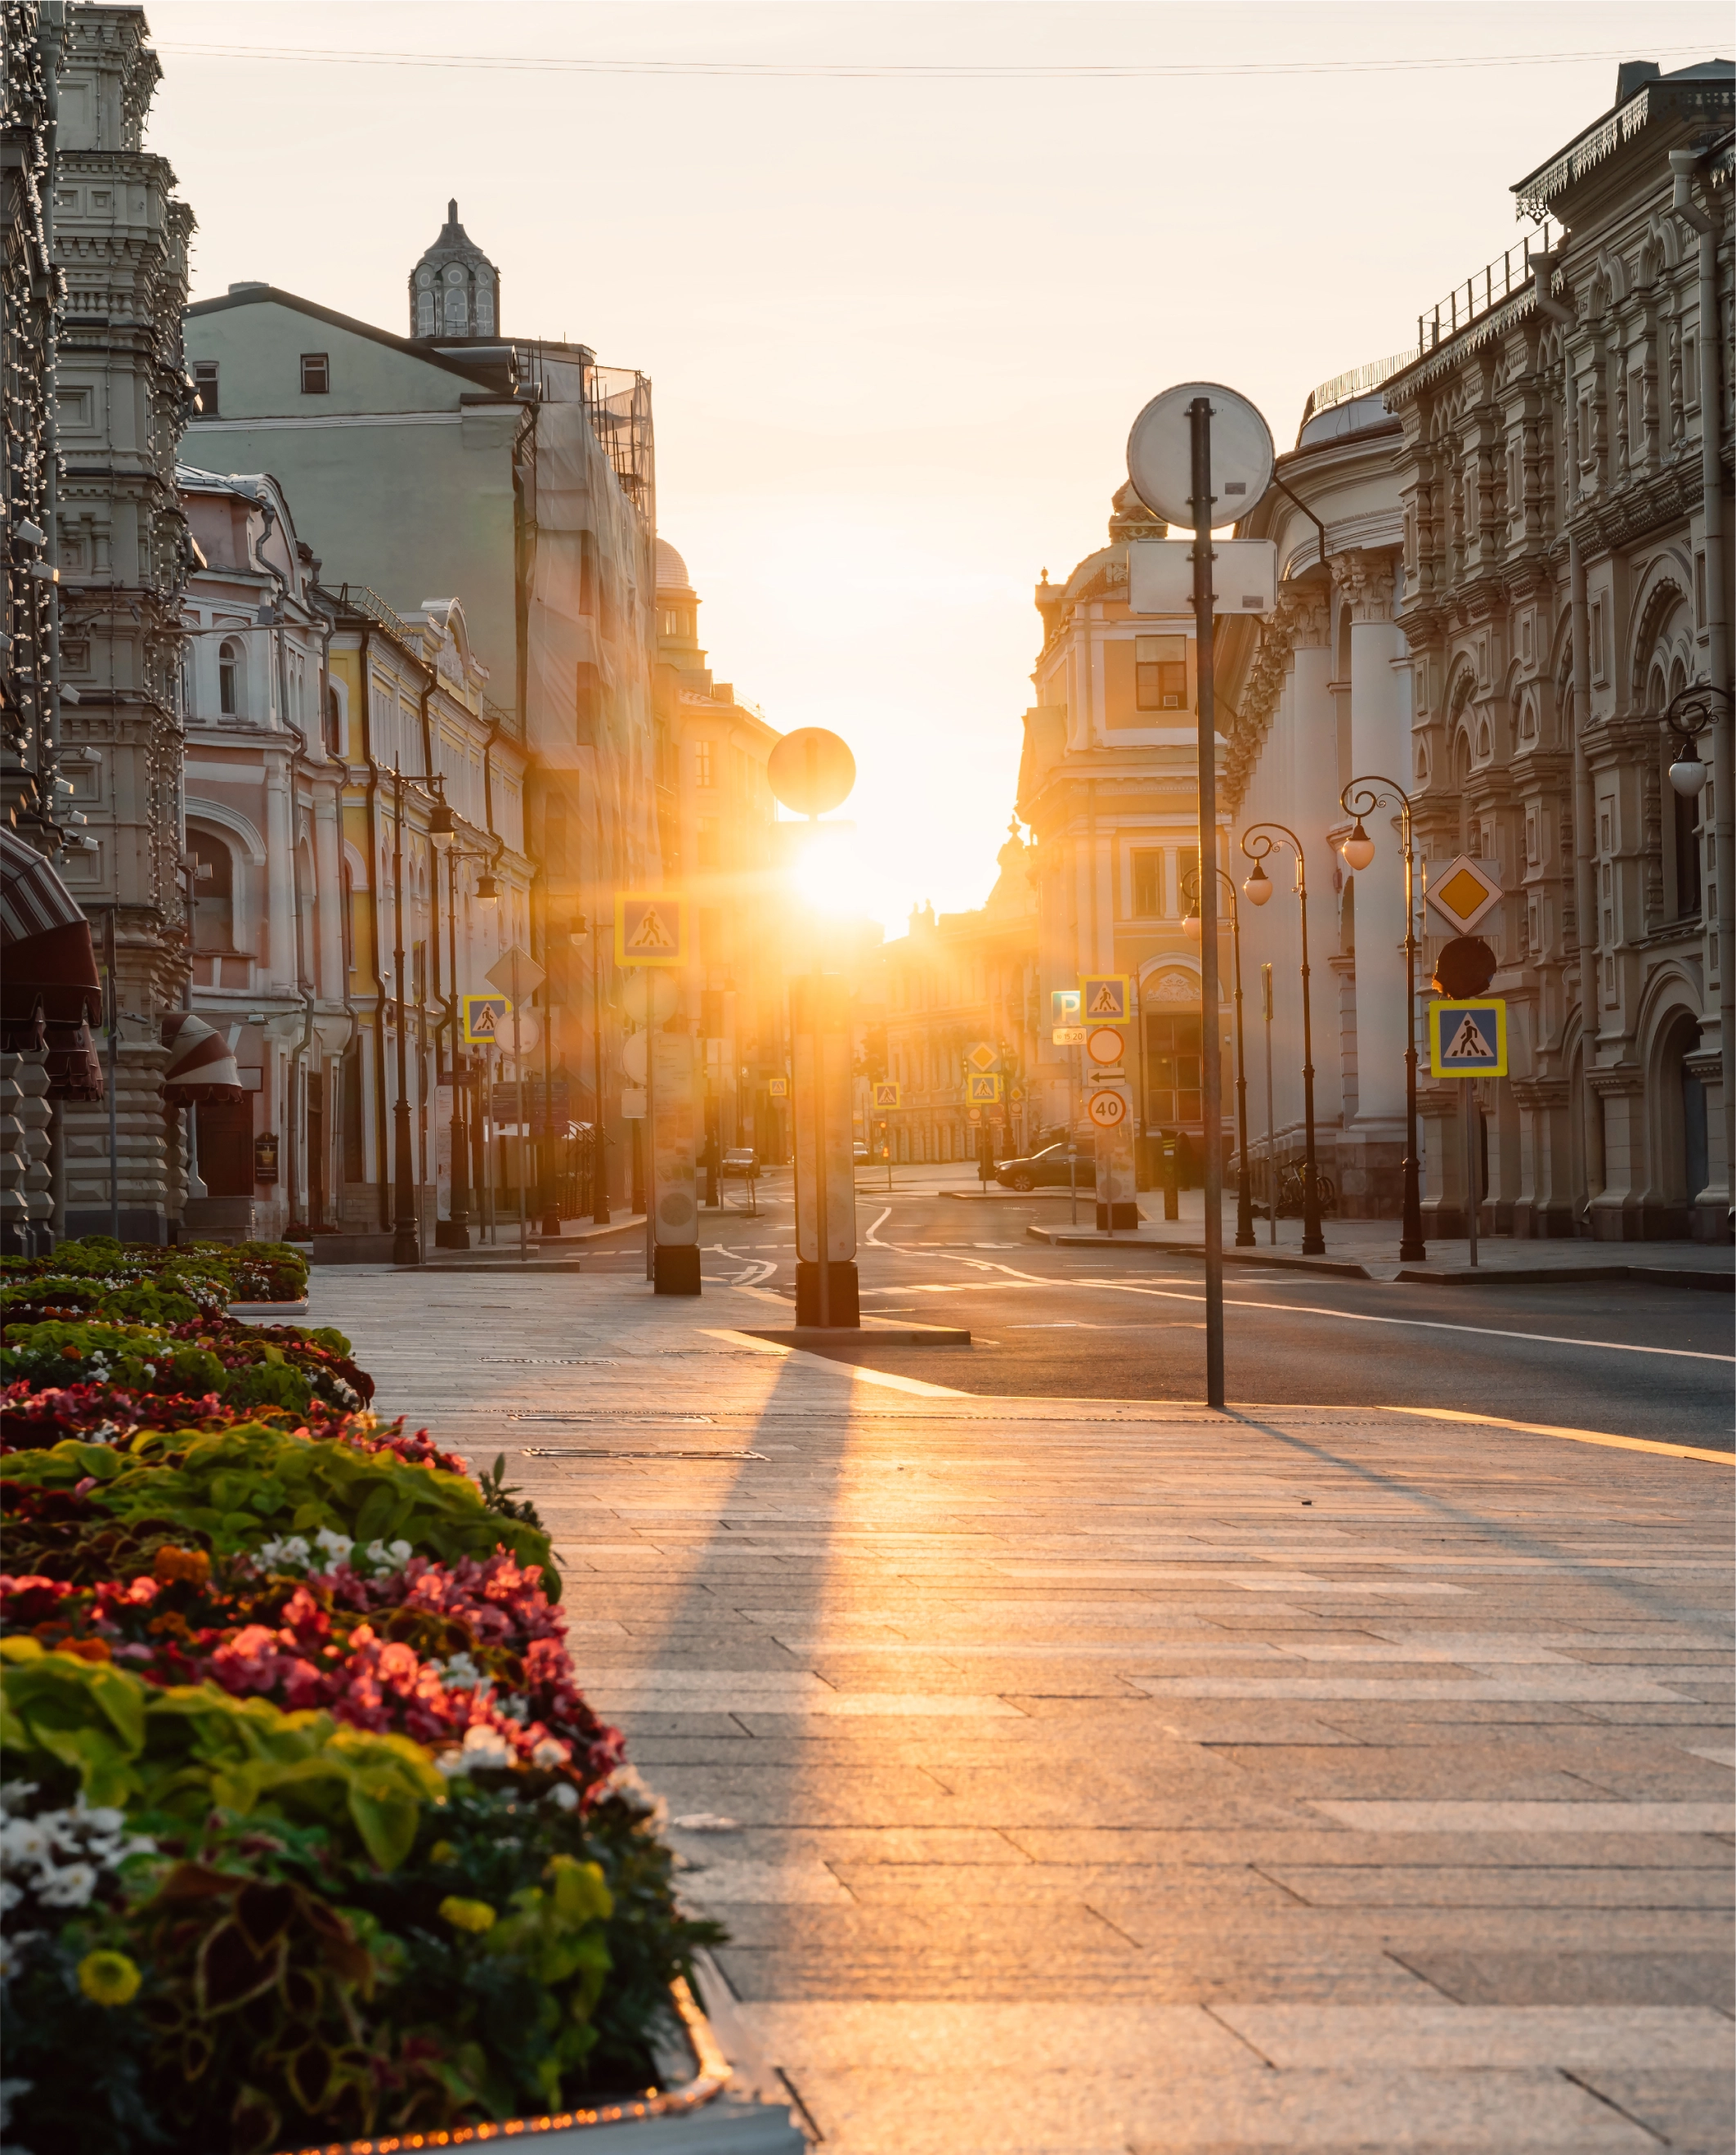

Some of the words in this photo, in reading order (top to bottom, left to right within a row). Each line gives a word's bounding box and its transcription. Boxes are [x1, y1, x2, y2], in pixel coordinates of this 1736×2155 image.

[1061, 994, 1079, 1022] P
[1072, 1032, 1083, 1040] 20
[1095, 1101, 1118, 1116] 40
